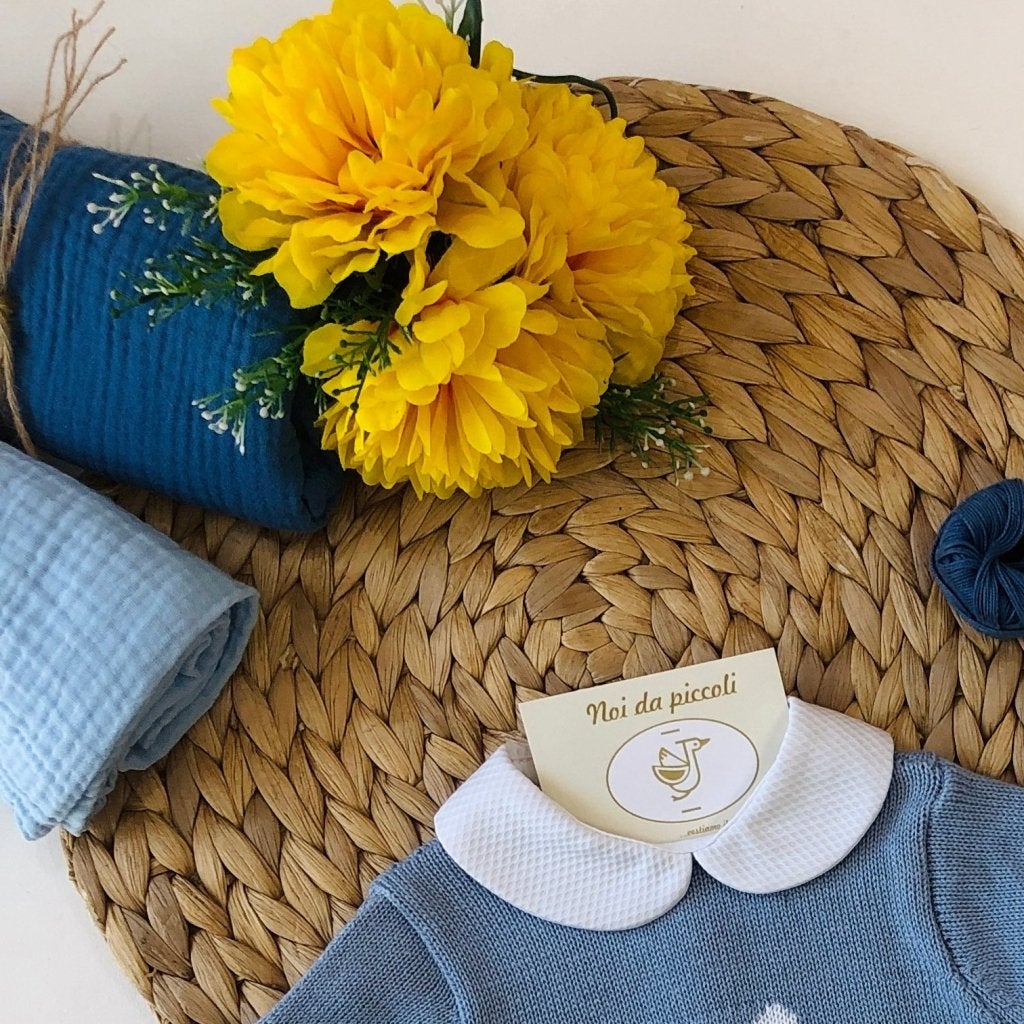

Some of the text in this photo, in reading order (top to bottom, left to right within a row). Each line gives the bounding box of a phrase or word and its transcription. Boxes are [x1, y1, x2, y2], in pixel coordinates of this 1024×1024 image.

[586, 671, 738, 725] Noi da piccoli
